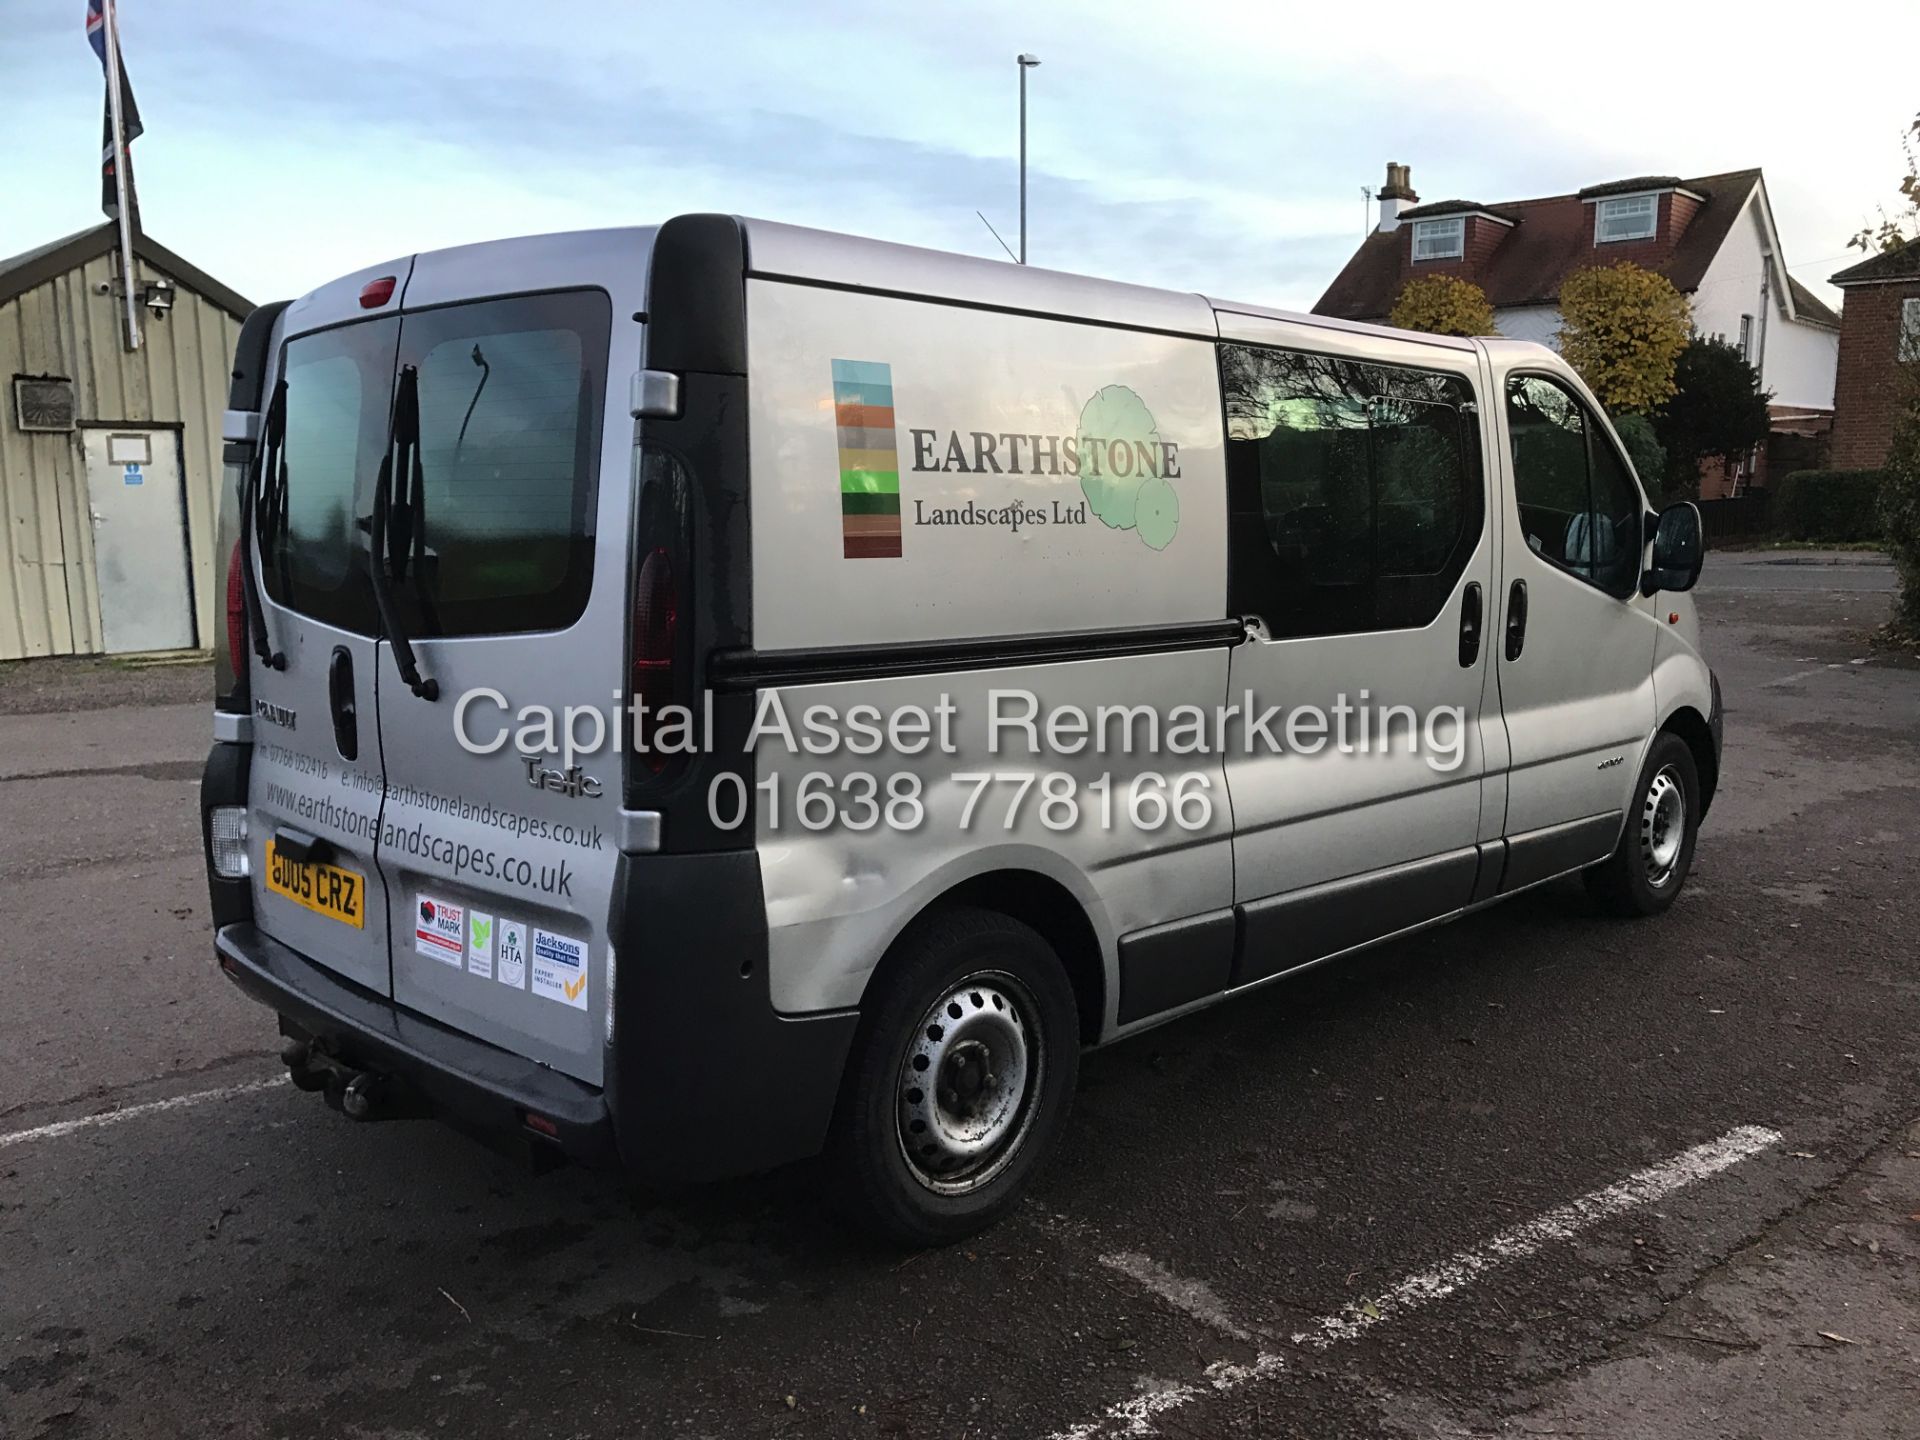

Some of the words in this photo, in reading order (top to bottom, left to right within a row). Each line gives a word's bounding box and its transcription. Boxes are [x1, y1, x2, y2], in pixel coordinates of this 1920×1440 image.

[910, 428, 1181, 479] EARTHSTONE
[914, 500, 1047, 532] Landscapes
[1052, 501, 1086, 525] Ltd
[341, 770, 350, 787] e.
[353, 769, 602, 850] info@earthstonelandscapes.co.uk
[266, 781, 573, 896] www.earthstonelandscapes.co.uk
[317, 867, 355, 916] CRZ
[437, 905, 461, 921] TRUST
[437, 917, 461, 935] MARK
[501, 944, 523, 964] HTA
[536, 932, 580, 956] Jacksons
